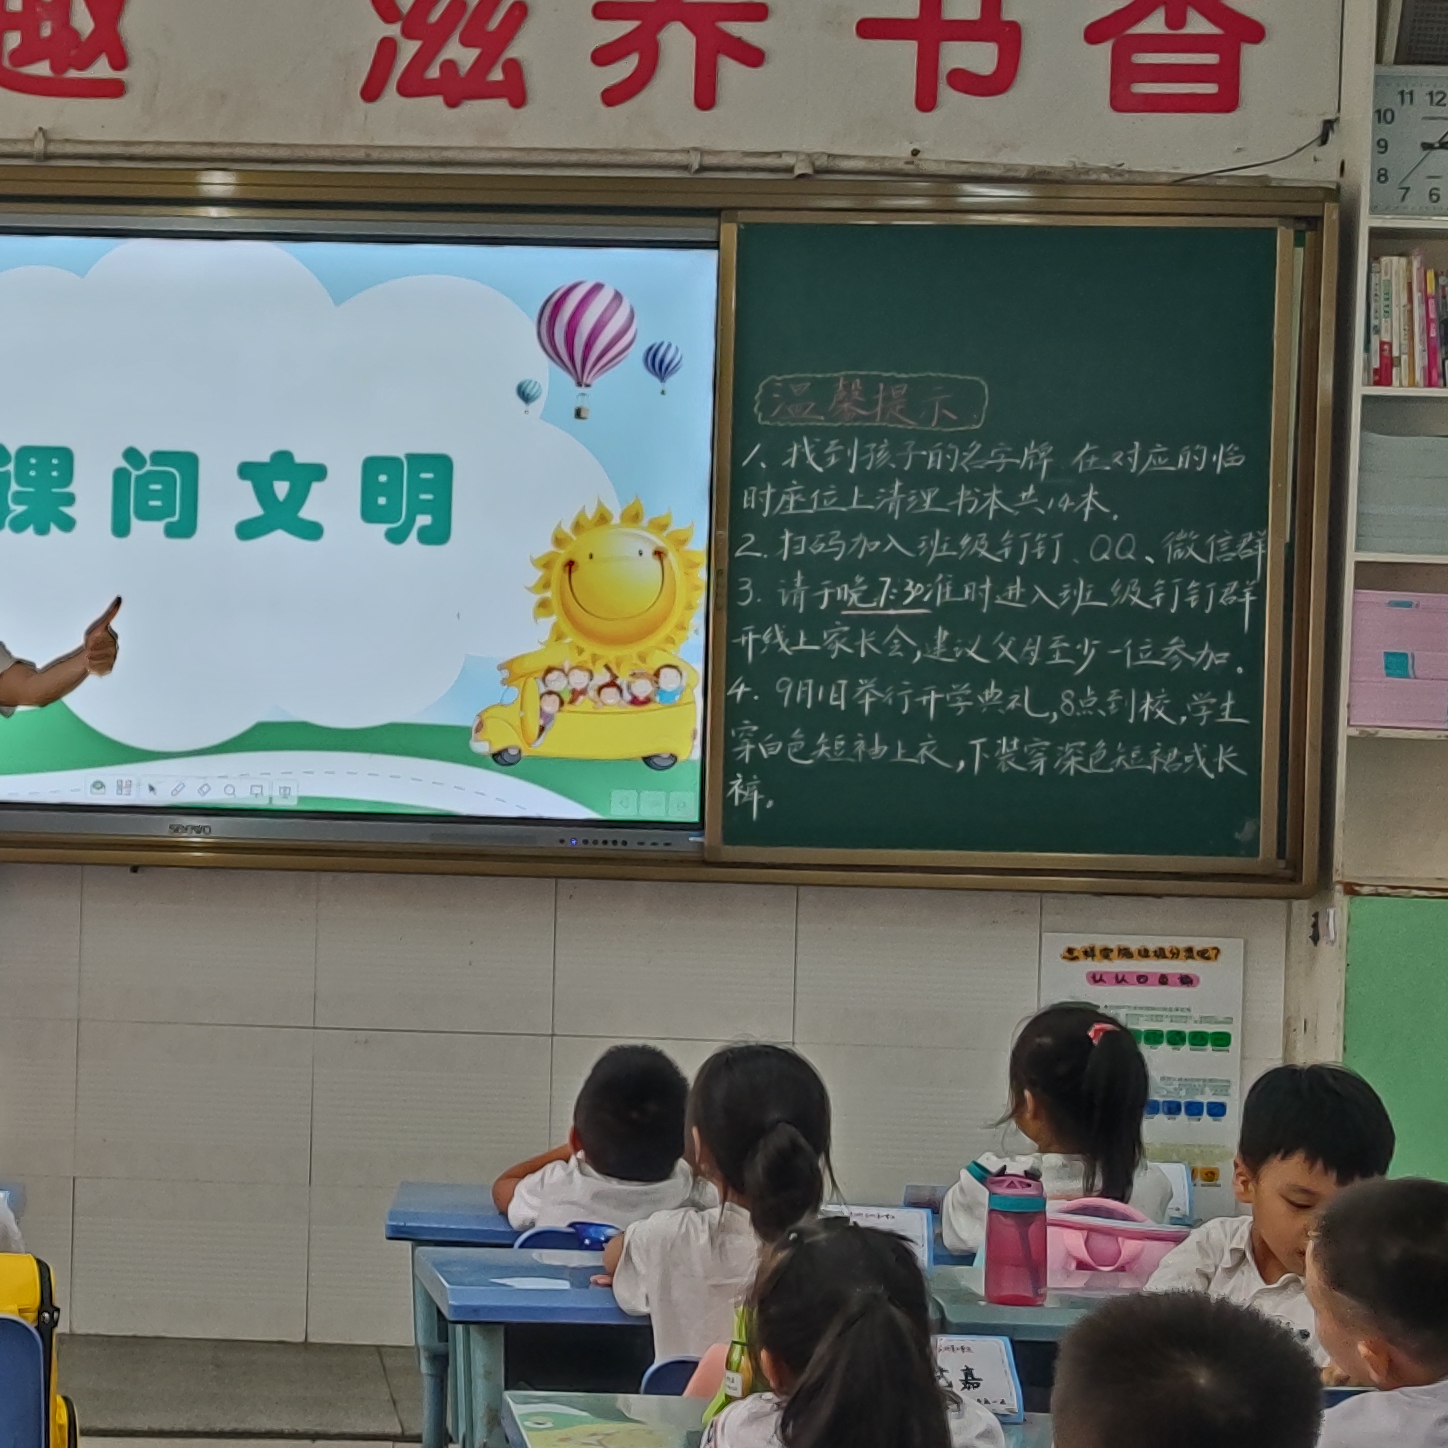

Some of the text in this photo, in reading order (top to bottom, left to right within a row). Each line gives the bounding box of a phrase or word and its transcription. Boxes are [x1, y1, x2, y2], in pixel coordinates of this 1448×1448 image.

[1398, 90, 1413, 105] 11
[1426, 90, 1447, 106] 12
[1374, 108, 1394, 124] 10
[1377, 138, 1388, 154] 9
[1377, 168, 1389, 184] 8
[1397, 186, 1410, 202] 7
[1429, 188, 1440, 203] 6
[771, 377, 957, 427] 温馨提示
